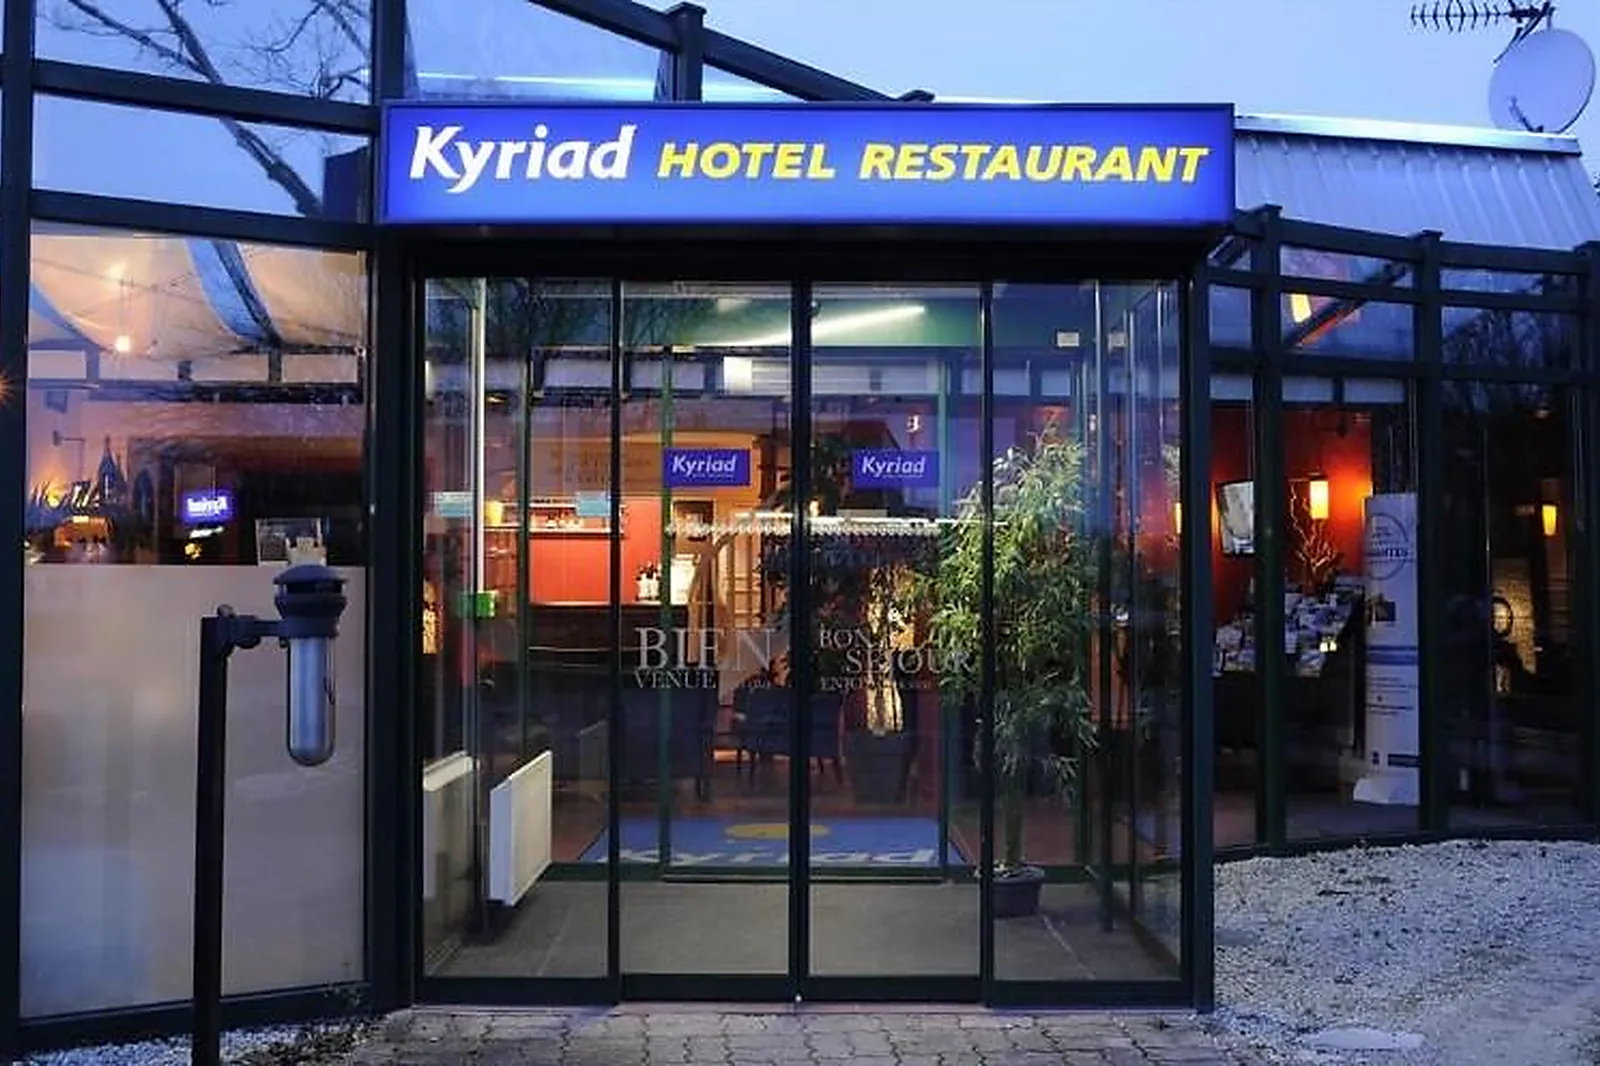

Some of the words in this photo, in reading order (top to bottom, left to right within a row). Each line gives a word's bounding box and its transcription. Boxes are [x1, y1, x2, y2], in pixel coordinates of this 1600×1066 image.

[409, 124, 636, 194] Kyriad
[656, 142, 837, 181] HOTEL
[859, 144, 1210, 184] RESTAURANT
[672, 454, 737, 477] Kyriad
[861, 456, 927, 478] Kyriad
[634, 627, 776, 671] BIEN
[634, 671, 717, 689] VENUE
